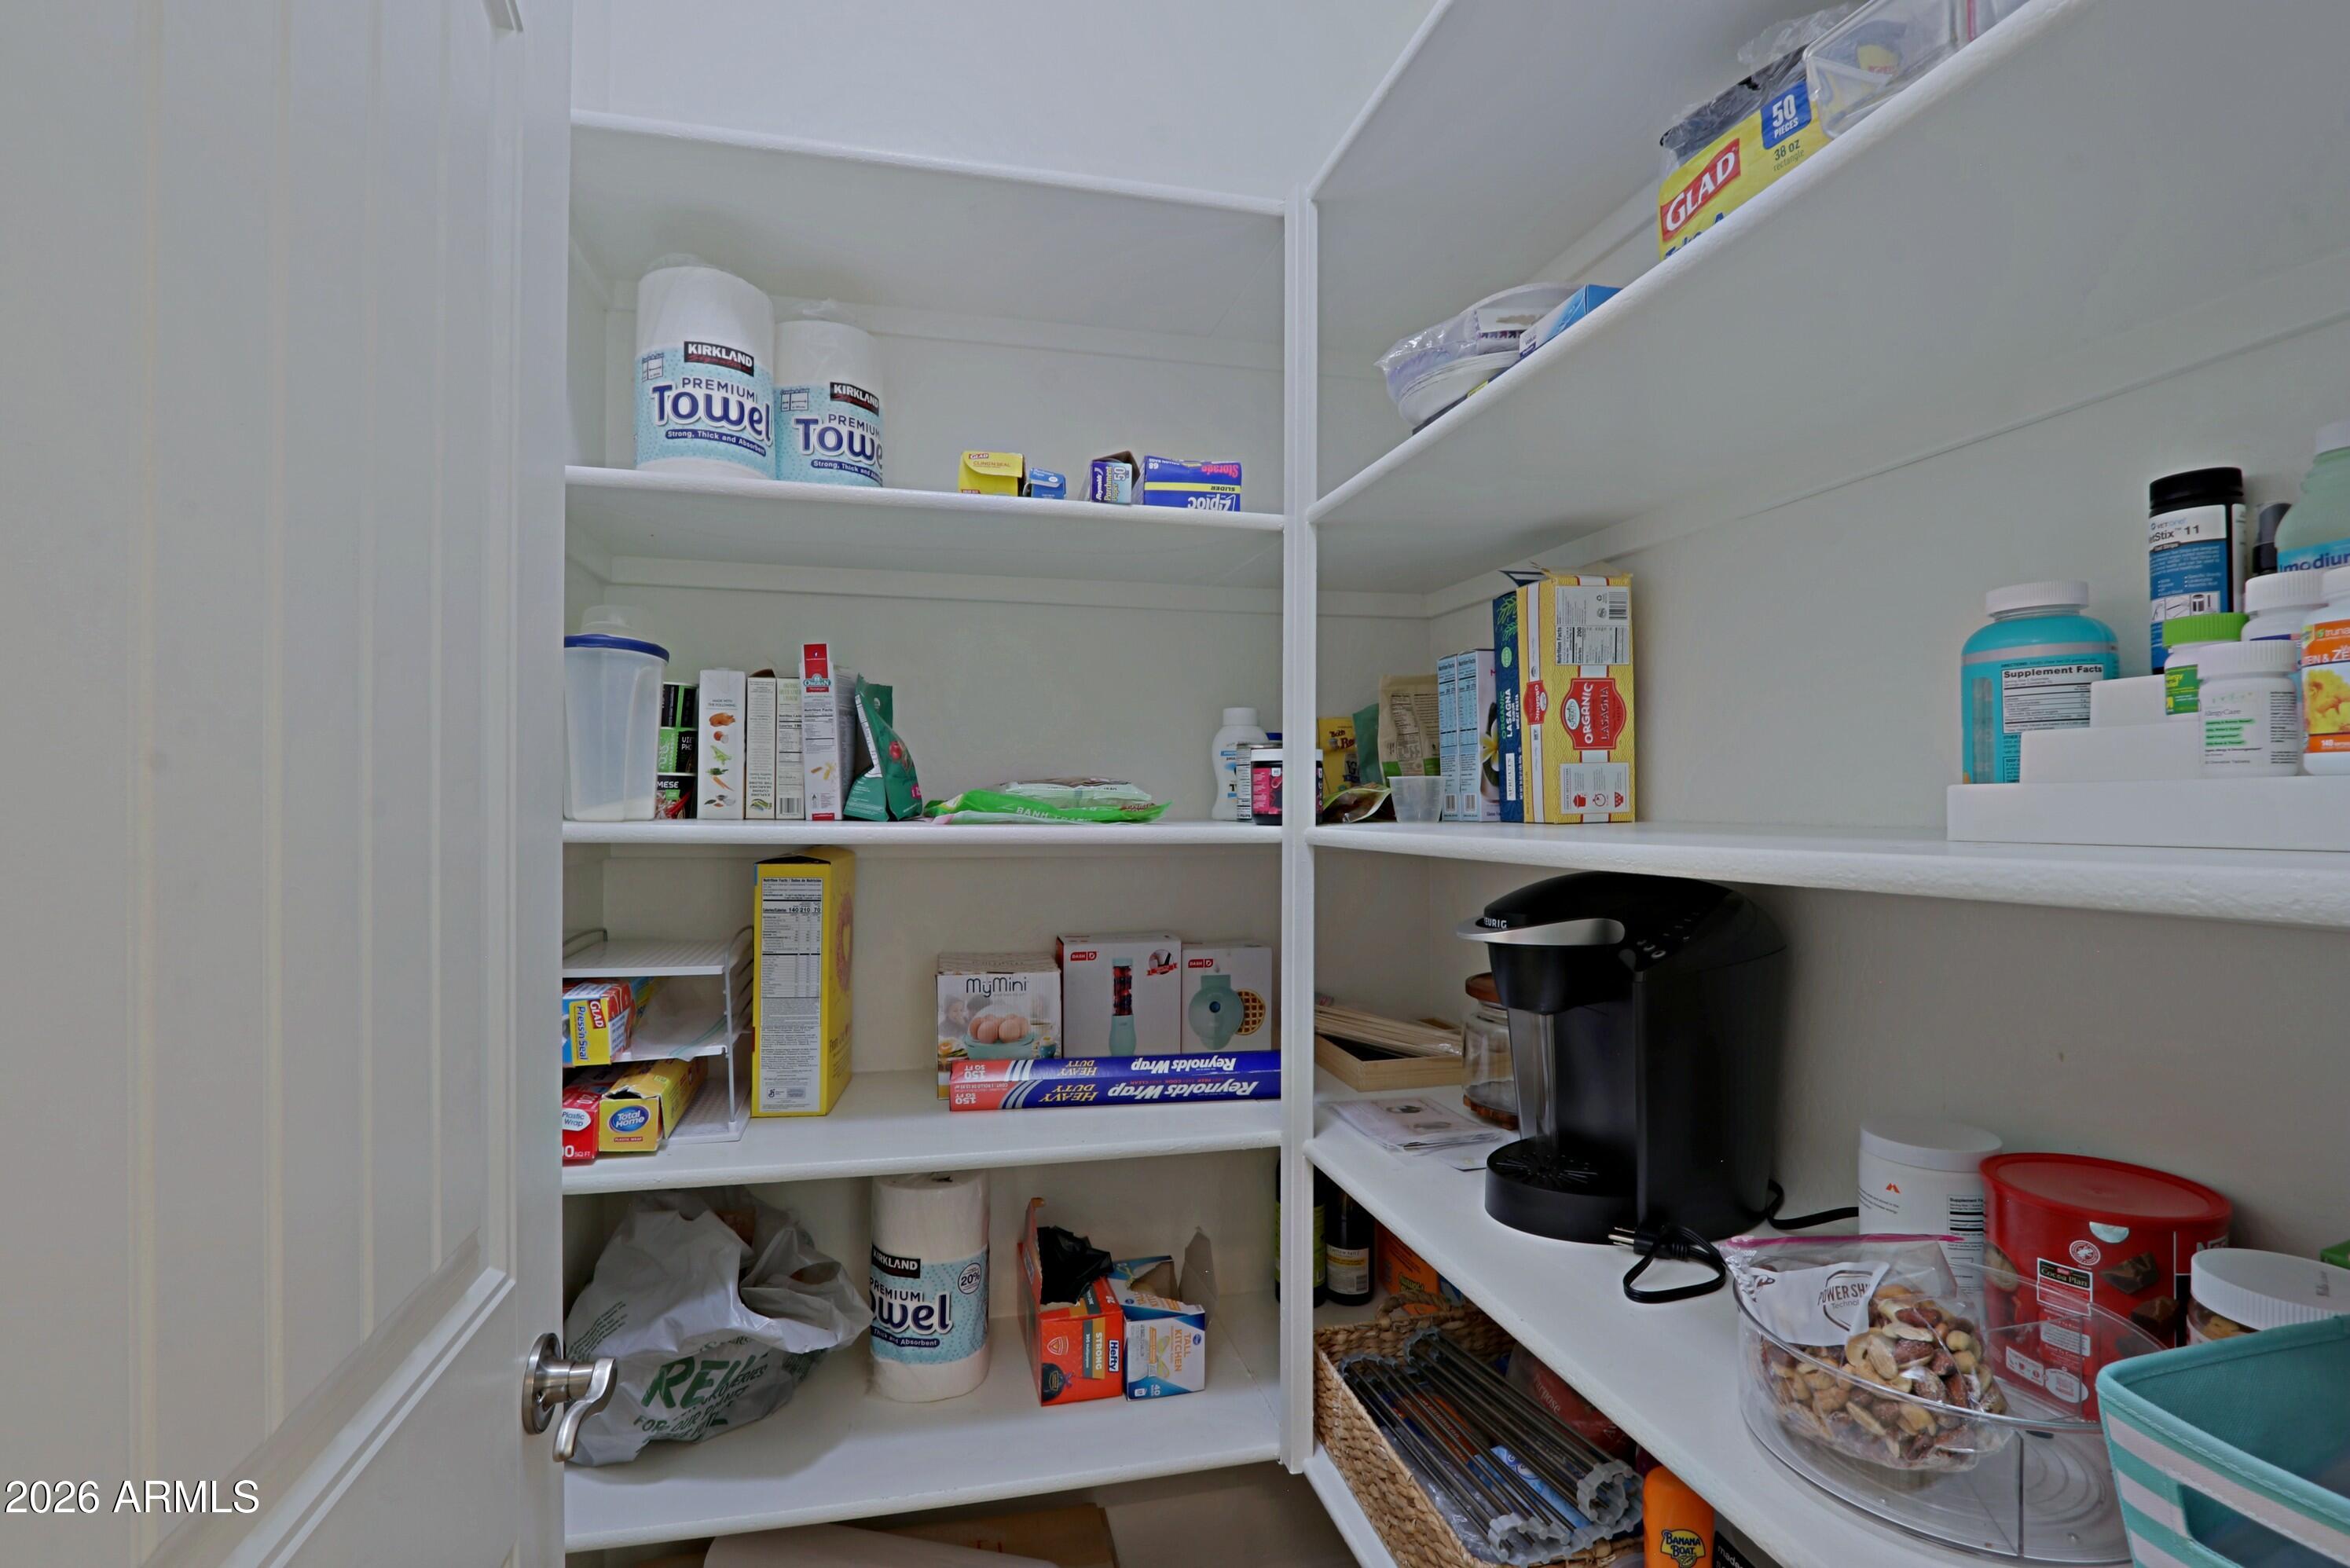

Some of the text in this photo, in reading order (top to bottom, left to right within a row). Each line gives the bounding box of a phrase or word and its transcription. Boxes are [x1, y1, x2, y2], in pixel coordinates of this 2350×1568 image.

[1772, 93, 1796, 128] 50
[1774, 117, 1798, 139] PIECES
[1773, 140, 1801, 161] 38 oz
[1773, 148, 1805, 171] rectangle
[1666, 152, 1735, 232] GLAD
[687, 343, 753, 368] KIRKLAND
[682, 377, 755, 401] PREMIUM
[833, 384, 879, 408] KIRKLAND
[652, 384, 771, 442] Towel
[698, 430, 720, 440] Thick
[722, 434, 736, 443] and
[795, 418, 883, 471] Towe
[841, 463, 859, 472] Thick
[1113, 467, 1126, 481] 50
[2004, 666, 2073, 679] Supplement
[1505, 688, 1513, 738] LASAGNA
[1581, 682, 1594, 744] ORGANIC
[1600, 686, 1610, 741] LASAGNA
[966, 976, 1027, 998] MyMini
[589, 1001, 604, 1028] GLAD
[1057, 1067, 1098, 1076] HEAVY
[1131, 1055, 1236, 1074] Reynolds Wrap
[964, 1071, 985, 1080] 150
[1039, 1091, 1098, 1101] HEAVY
[1107, 1079, 1259, 1100] Reynolds Wrap
[562, 1111, 585, 1120] Plastic
[565, 1118, 584, 1127] Wrap
[615, 1116, 645, 1128] Home
[617, 1110, 641, 1121] Total
[563, 1145, 574, 1157] 0
[873, 1249, 918, 1271] KIRKLAND
[960, 1271, 981, 1287] 20%
[2040, 1267, 2088, 1287] Cocoa Plan
[870, 1277, 920, 1302] PREMIUM
[870, 1292, 950, 1331] wel
[1831, 1299, 1860, 1310] Technol
[1109, 1341, 1118, 1371] Hefty
[1153, 1384, 1160, 1396] 40
[1664, 1531, 1701, 1546] BANANA
[1671, 1544, 1696, 1557] BOAT
